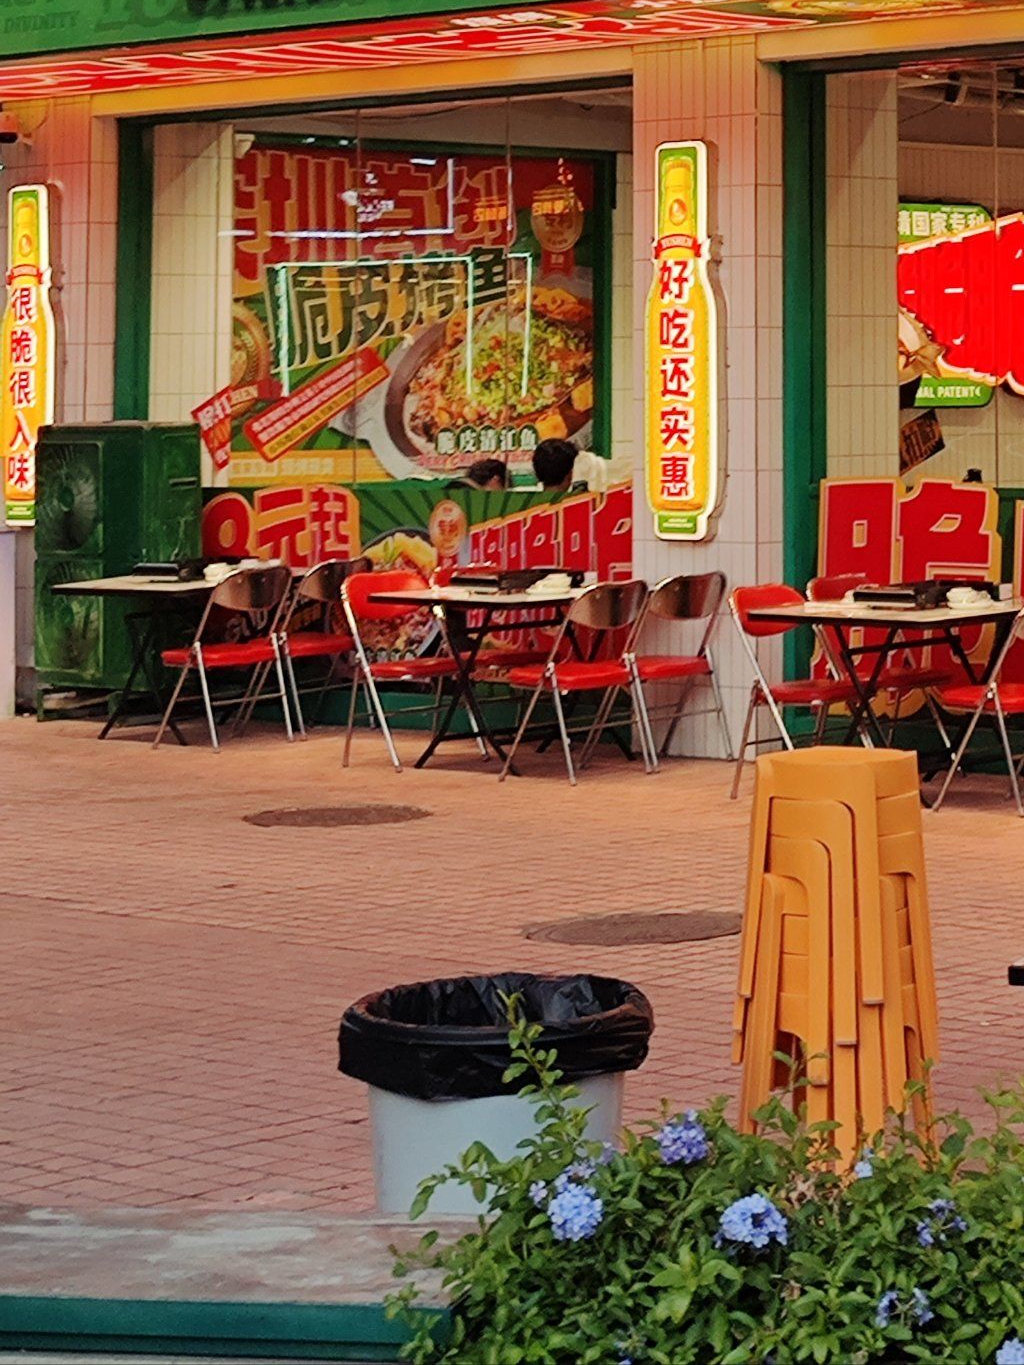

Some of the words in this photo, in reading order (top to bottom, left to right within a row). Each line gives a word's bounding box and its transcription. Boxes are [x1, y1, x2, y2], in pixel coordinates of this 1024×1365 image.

[8, 287, 36, 492] 很脆很入味
[659, 260, 691, 497] 好吃还实惠
